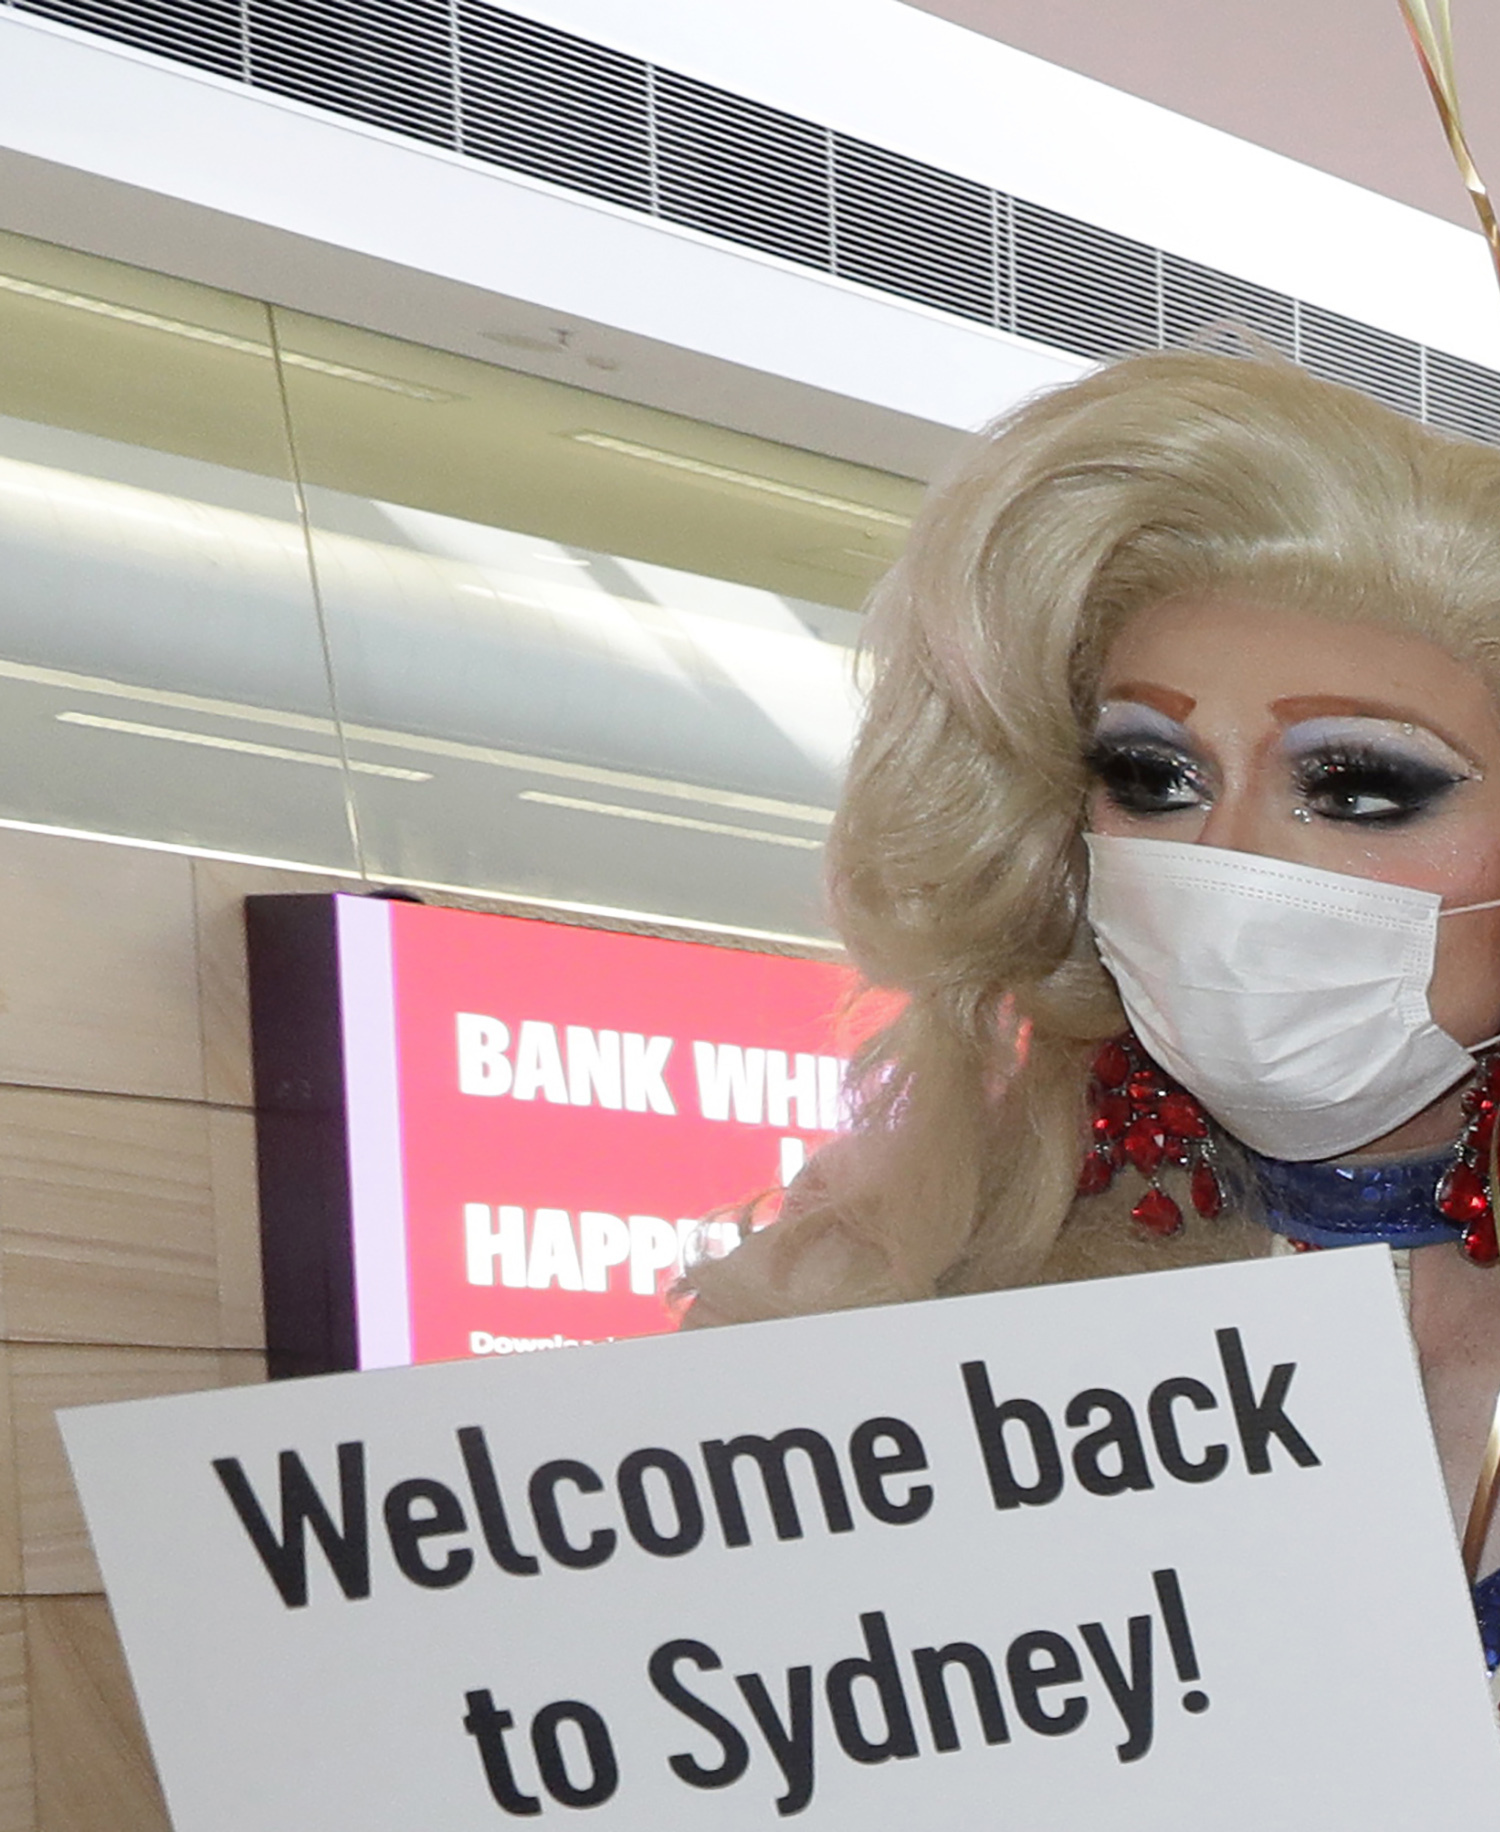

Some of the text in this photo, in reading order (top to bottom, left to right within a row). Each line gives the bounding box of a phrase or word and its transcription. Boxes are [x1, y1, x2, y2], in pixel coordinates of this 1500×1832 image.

[455, 1011, 675, 1116] BANK
[212, 1327, 1322, 1610] Welcome back
[463, 1568, 1210, 1817] to Sydney!
